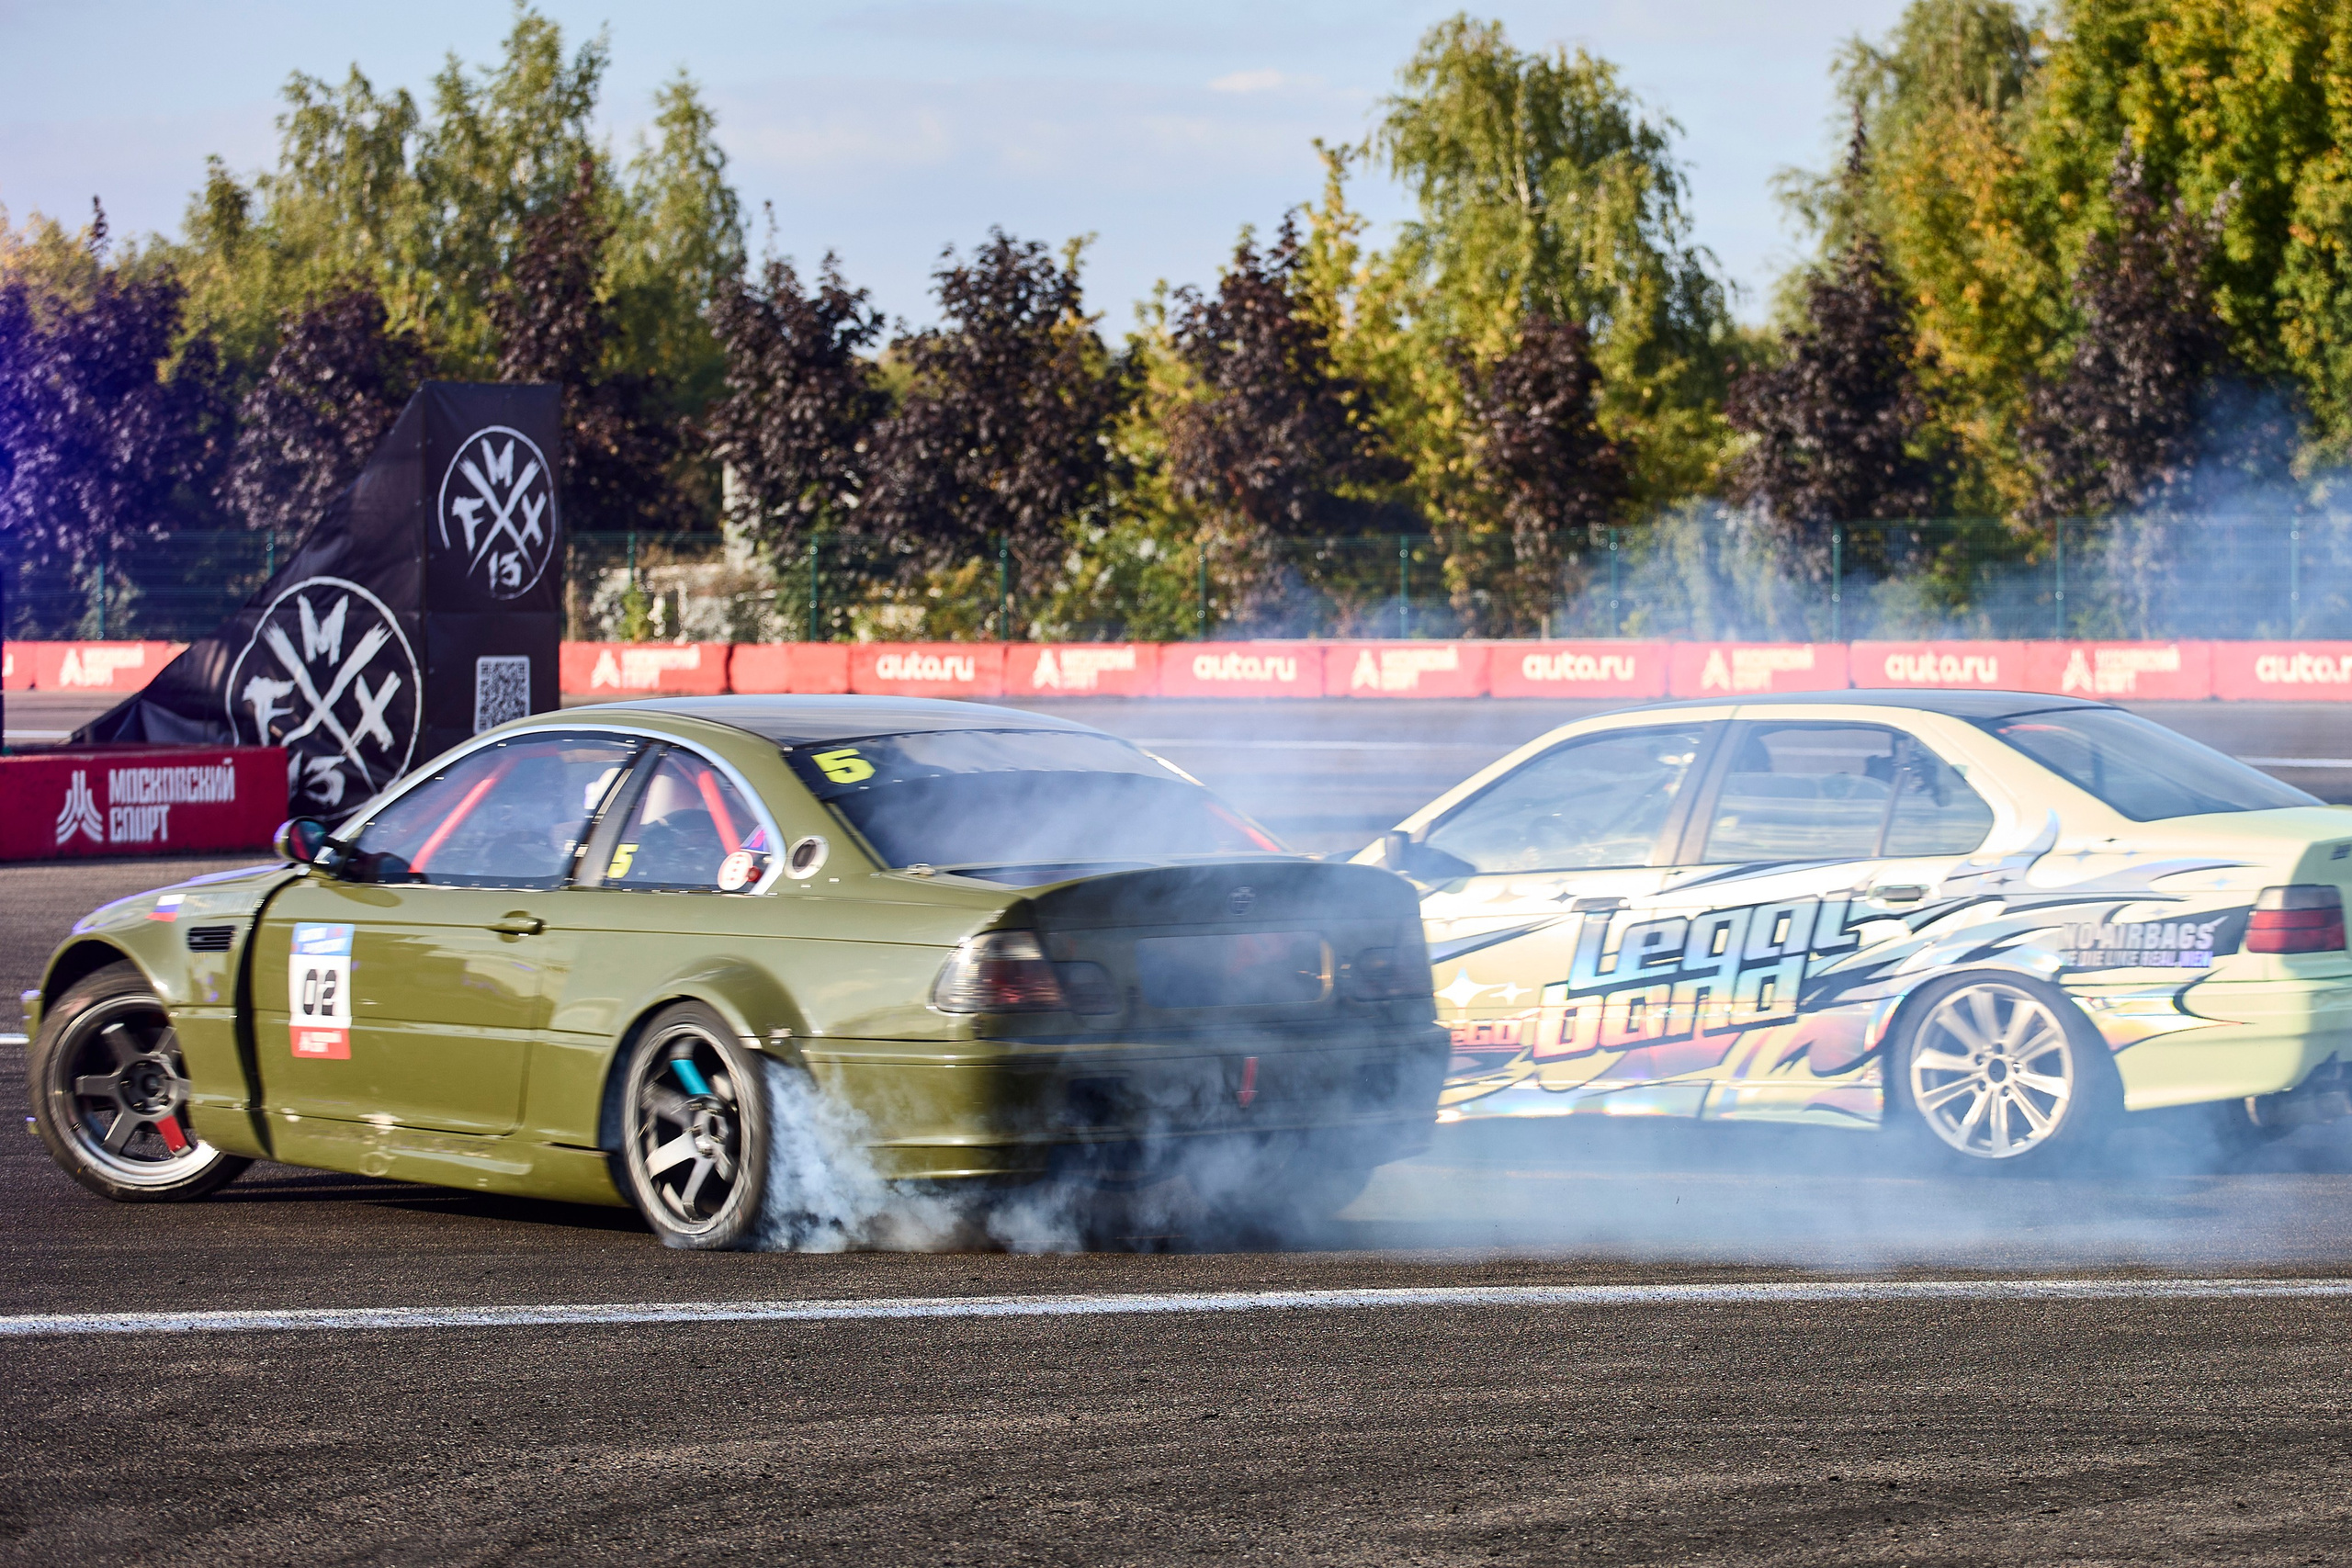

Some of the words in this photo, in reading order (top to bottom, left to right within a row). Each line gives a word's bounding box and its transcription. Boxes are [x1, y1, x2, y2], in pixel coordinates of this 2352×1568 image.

[488, 550, 523, 591] 13
[876, 650, 976, 682] auto.ru
[1193, 650, 1297, 682] auto.ru
[1521, 650, 1635, 682] auto.ru
[1883, 649, 1999, 683] auto.ru
[2255, 649, 2352, 683] auto.r
[108, 757, 236, 805] МОСКОВСКИЙ
[811, 748, 876, 784] 5
[109, 804, 171, 843] СПОРТ
[607, 843, 639, 878] 5
[2096, 920, 2217, 950] AIRBAGS
[302, 968, 337, 1017] 02
